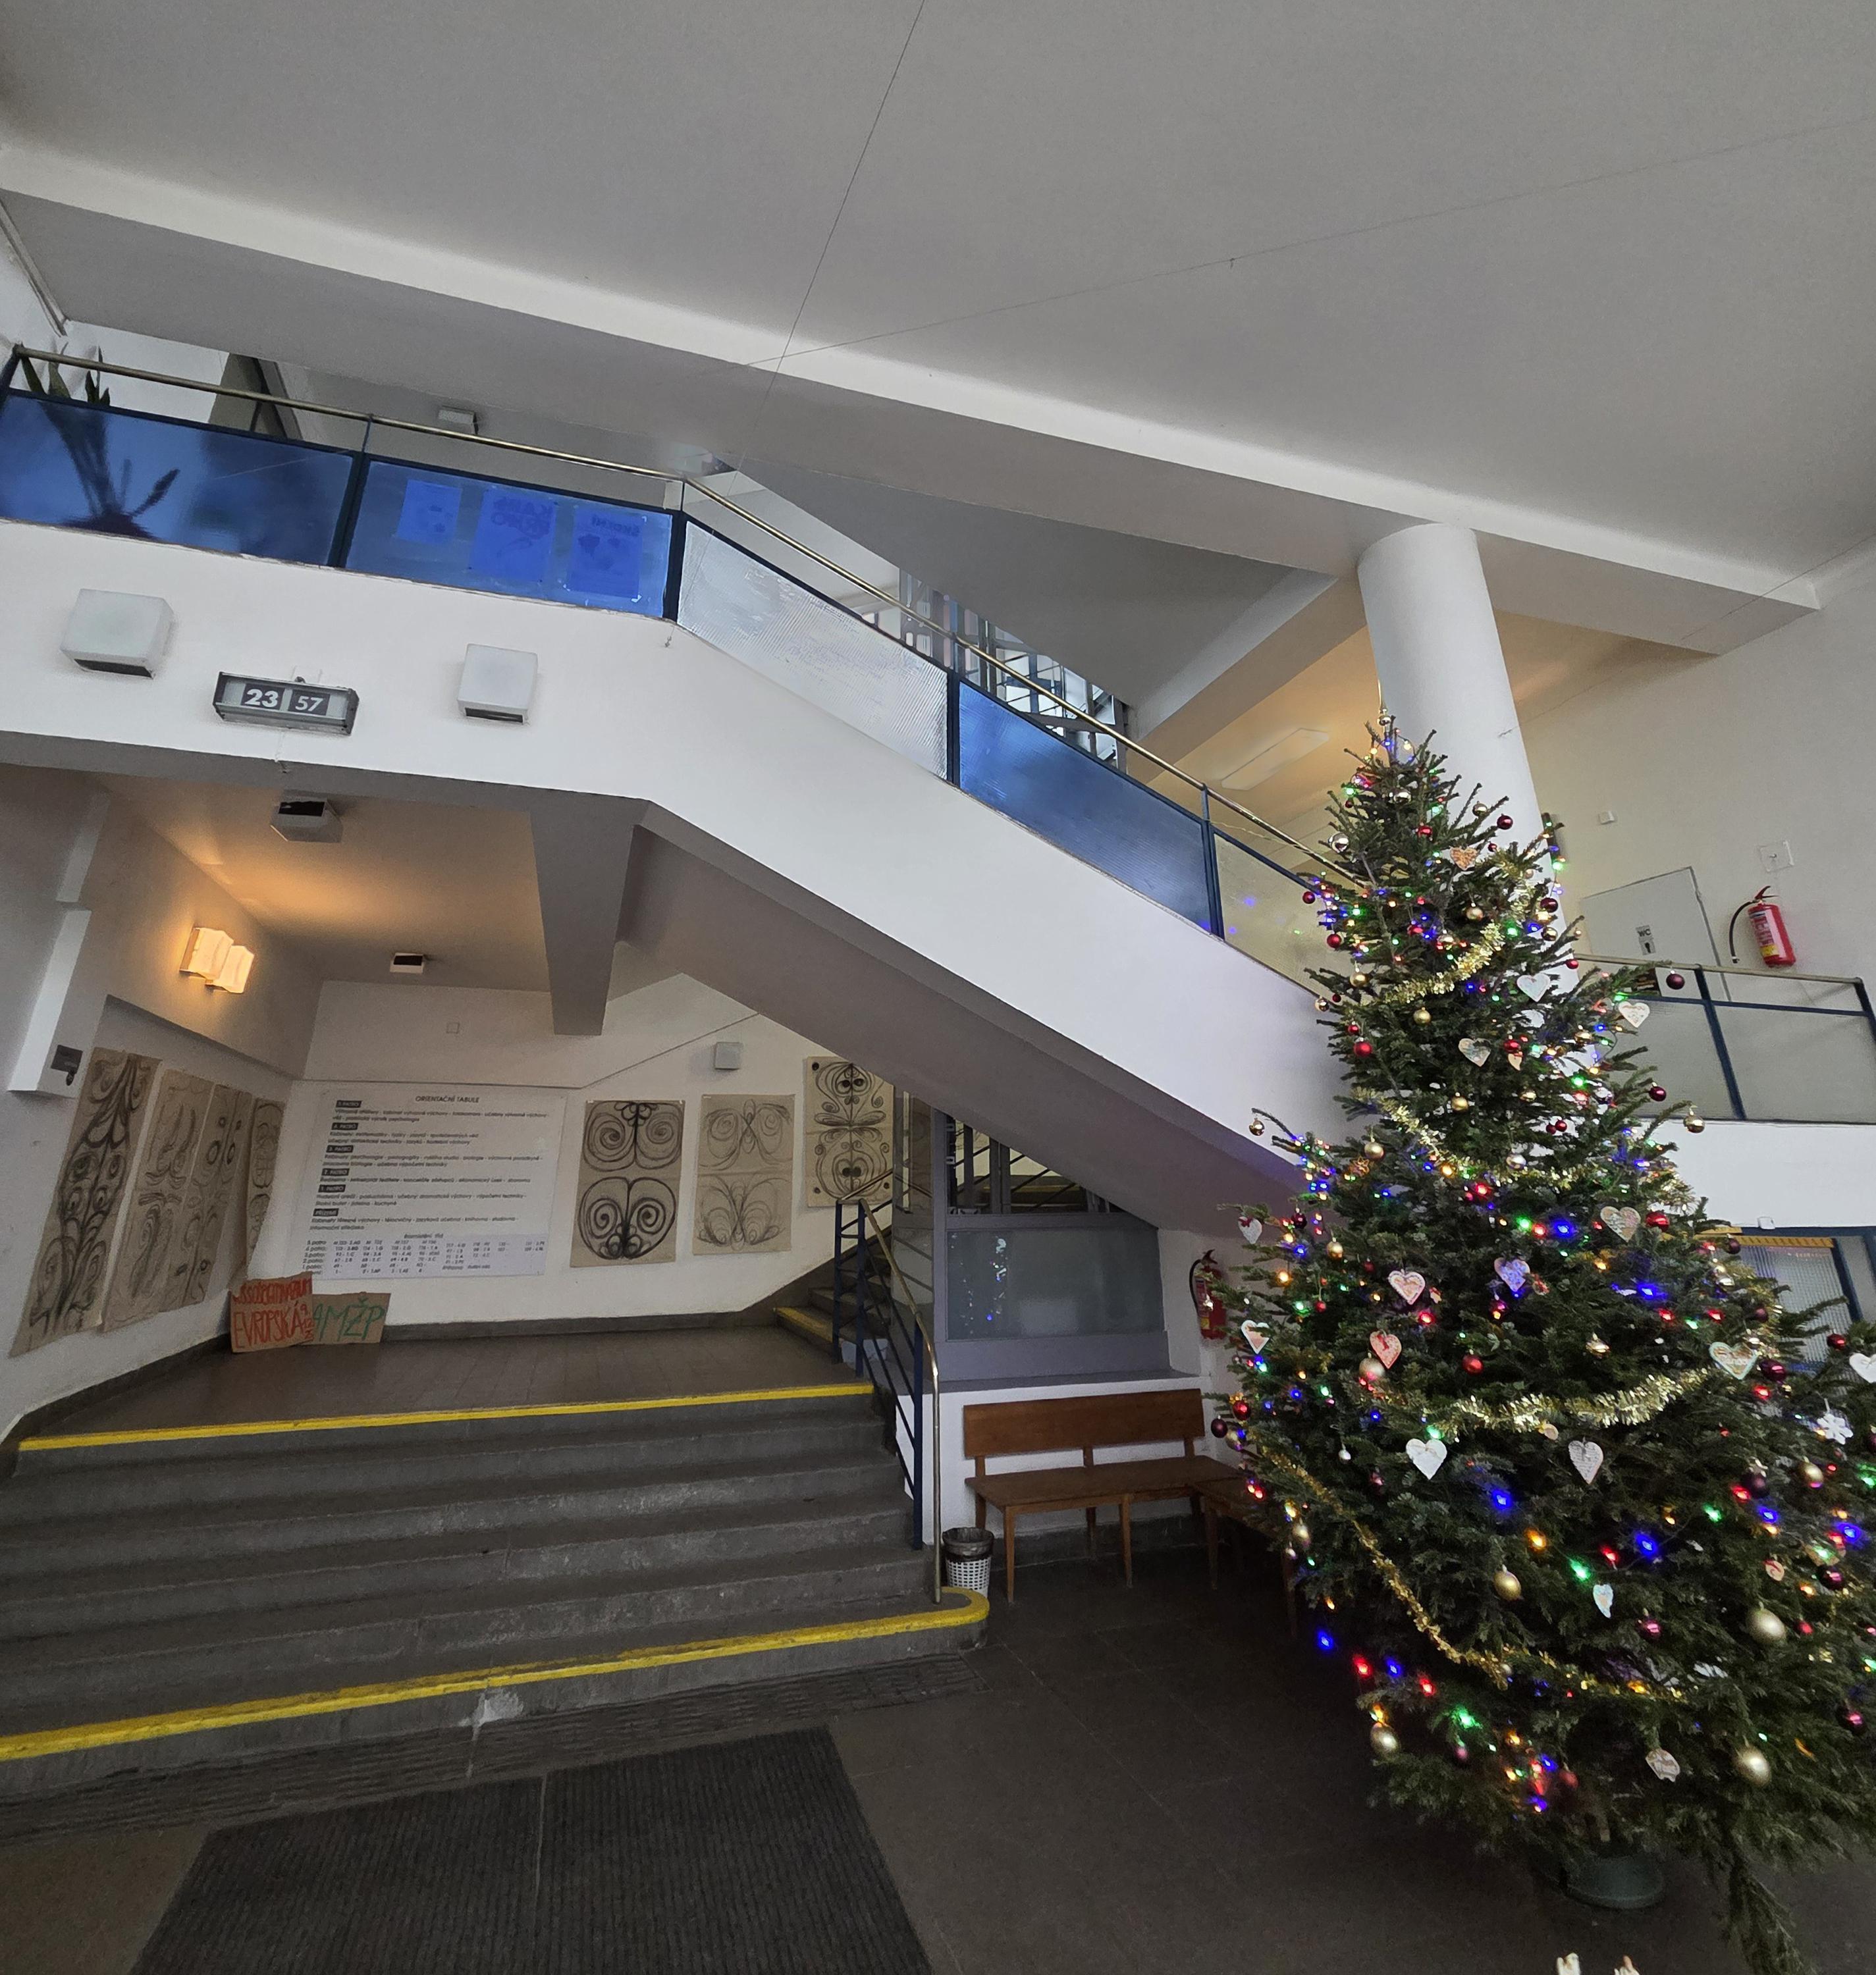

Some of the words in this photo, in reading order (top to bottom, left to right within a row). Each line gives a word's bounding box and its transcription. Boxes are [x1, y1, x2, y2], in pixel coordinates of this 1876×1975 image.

[244, 689, 279, 708] 23
[295, 695, 323, 712] 57
[1638, 928, 1651, 937] WC
[234, 1300, 306, 1348] EVROPSKÁ
